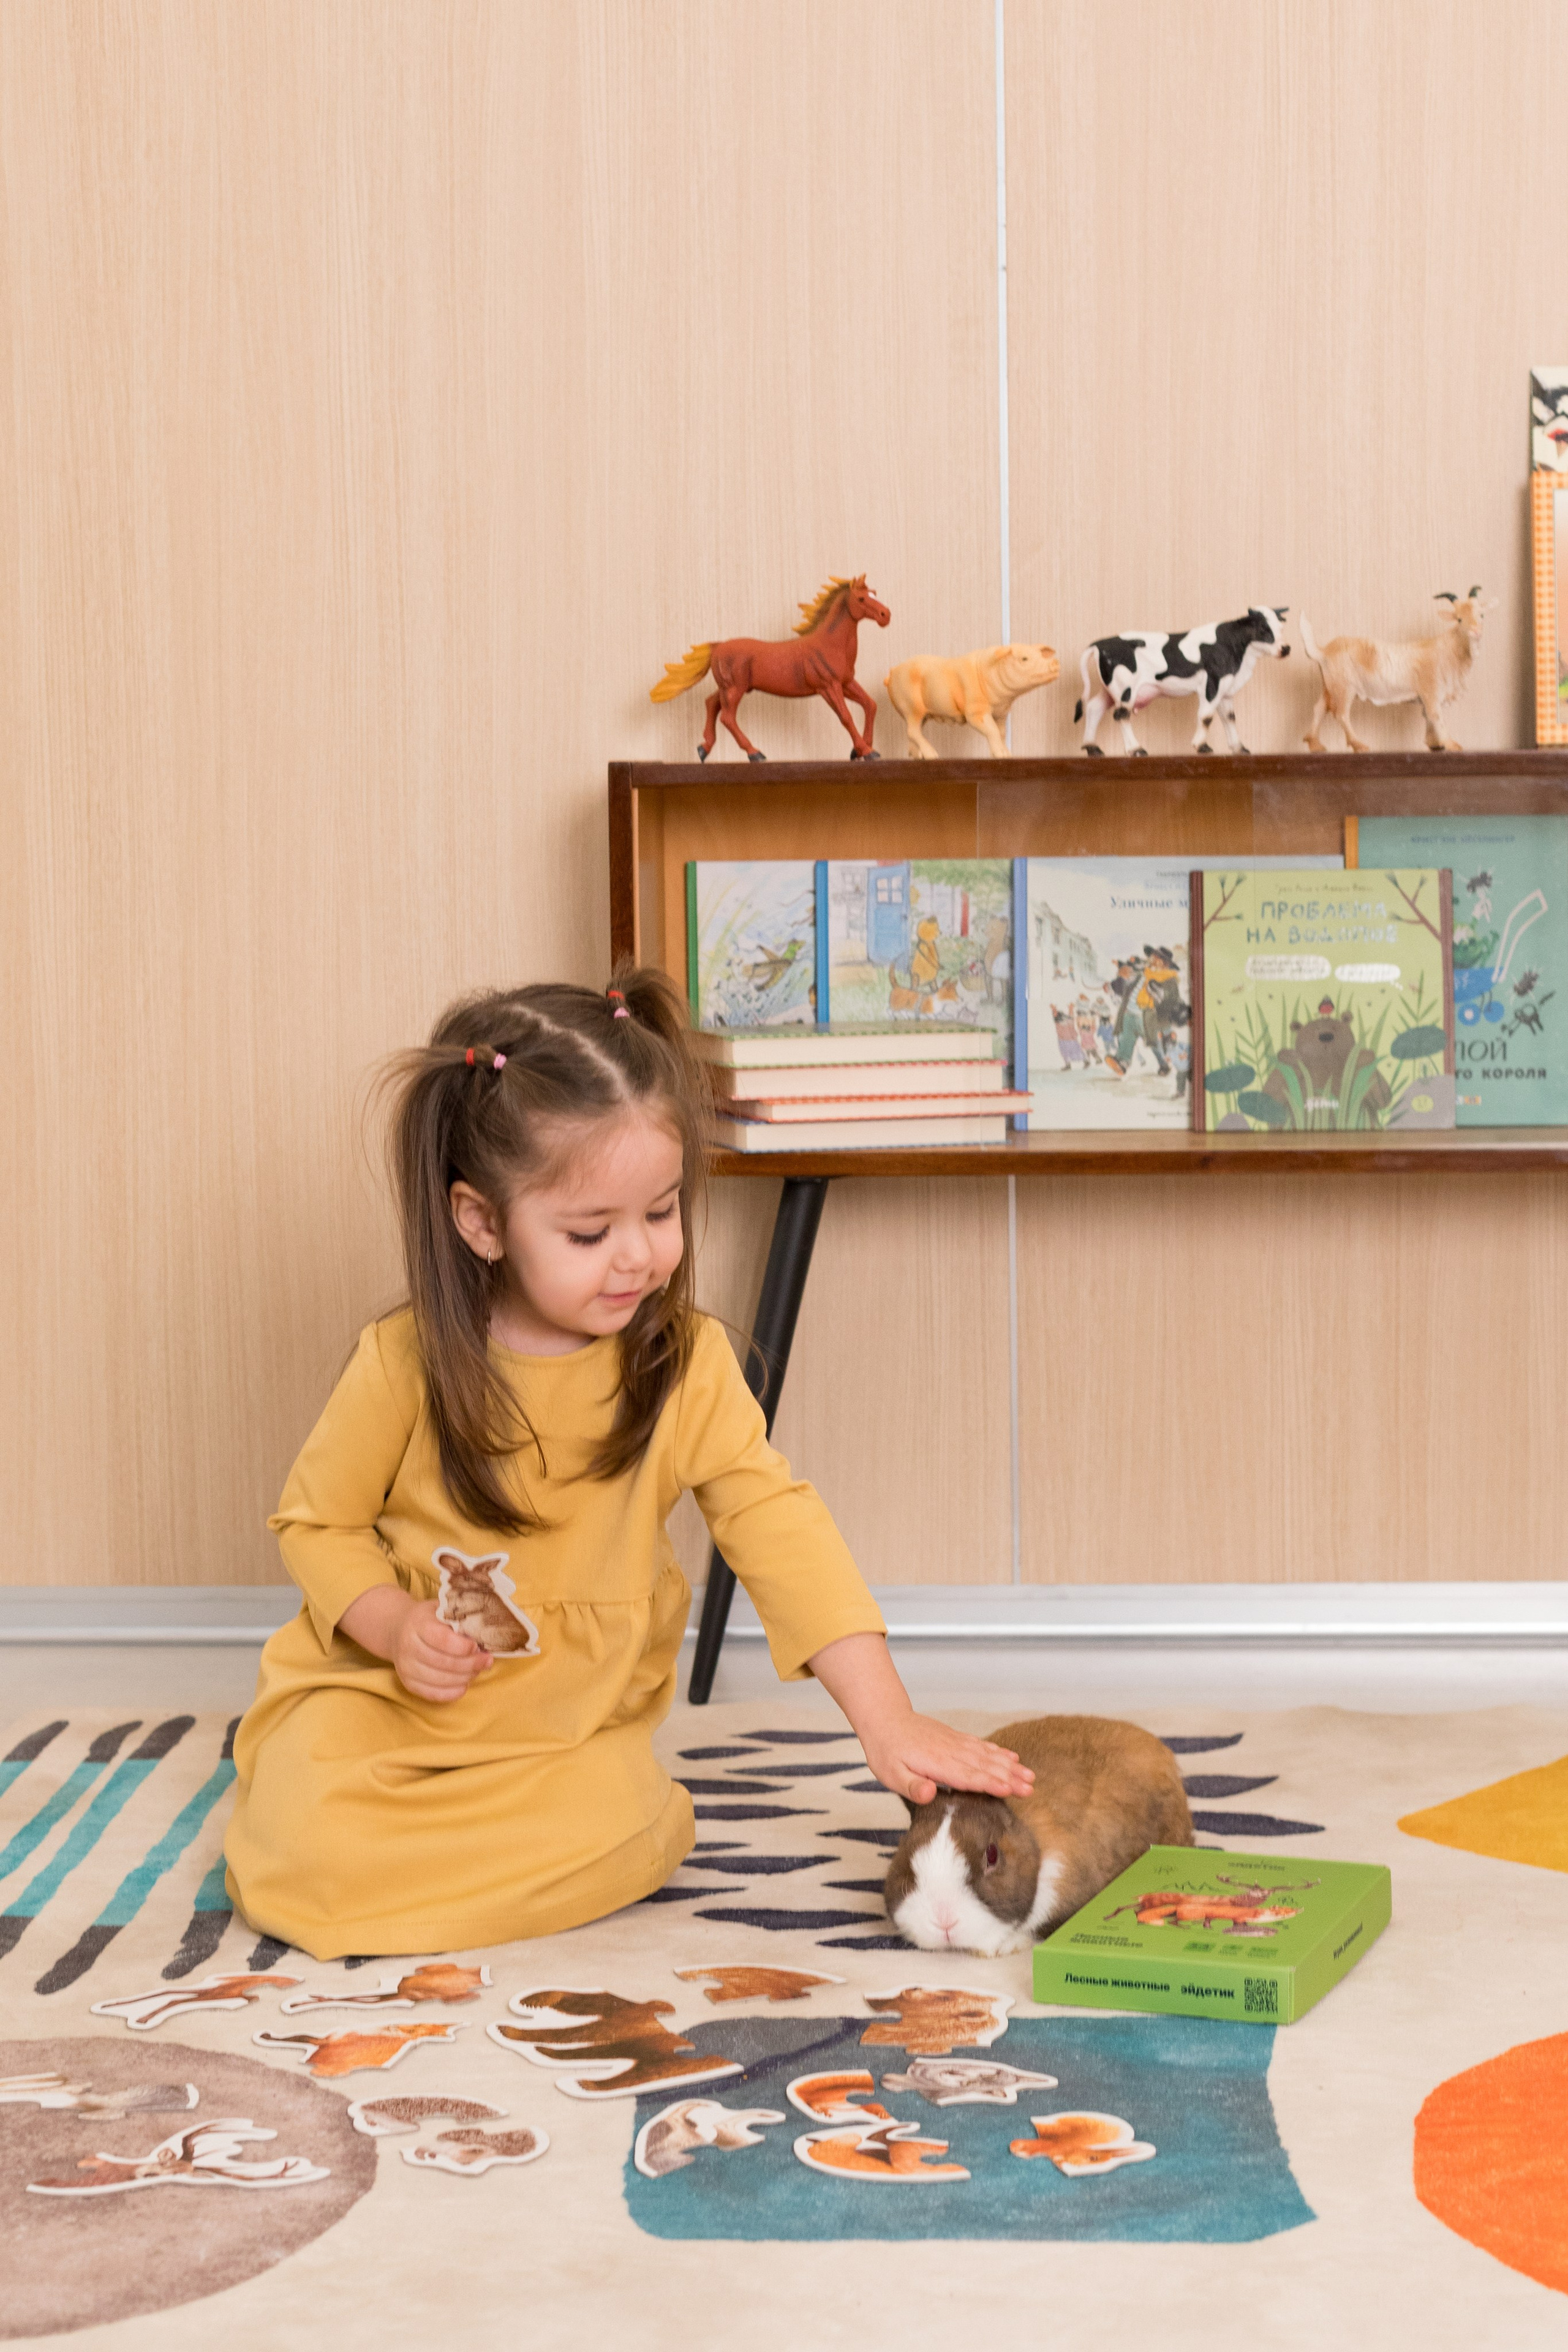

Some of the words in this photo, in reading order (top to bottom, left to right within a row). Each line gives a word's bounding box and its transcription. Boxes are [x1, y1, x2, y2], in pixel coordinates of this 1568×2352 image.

[1110, 895, 1172, 909] Уличные
[1261, 900, 1387, 920] ПРОБЛЕМА
[1246, 926, 1276, 944] НА
[1065, 1972, 1109, 1986] Лесные
[1111, 1977, 1170, 1992] животные
[1181, 1981, 1235, 1999] эйдетик
